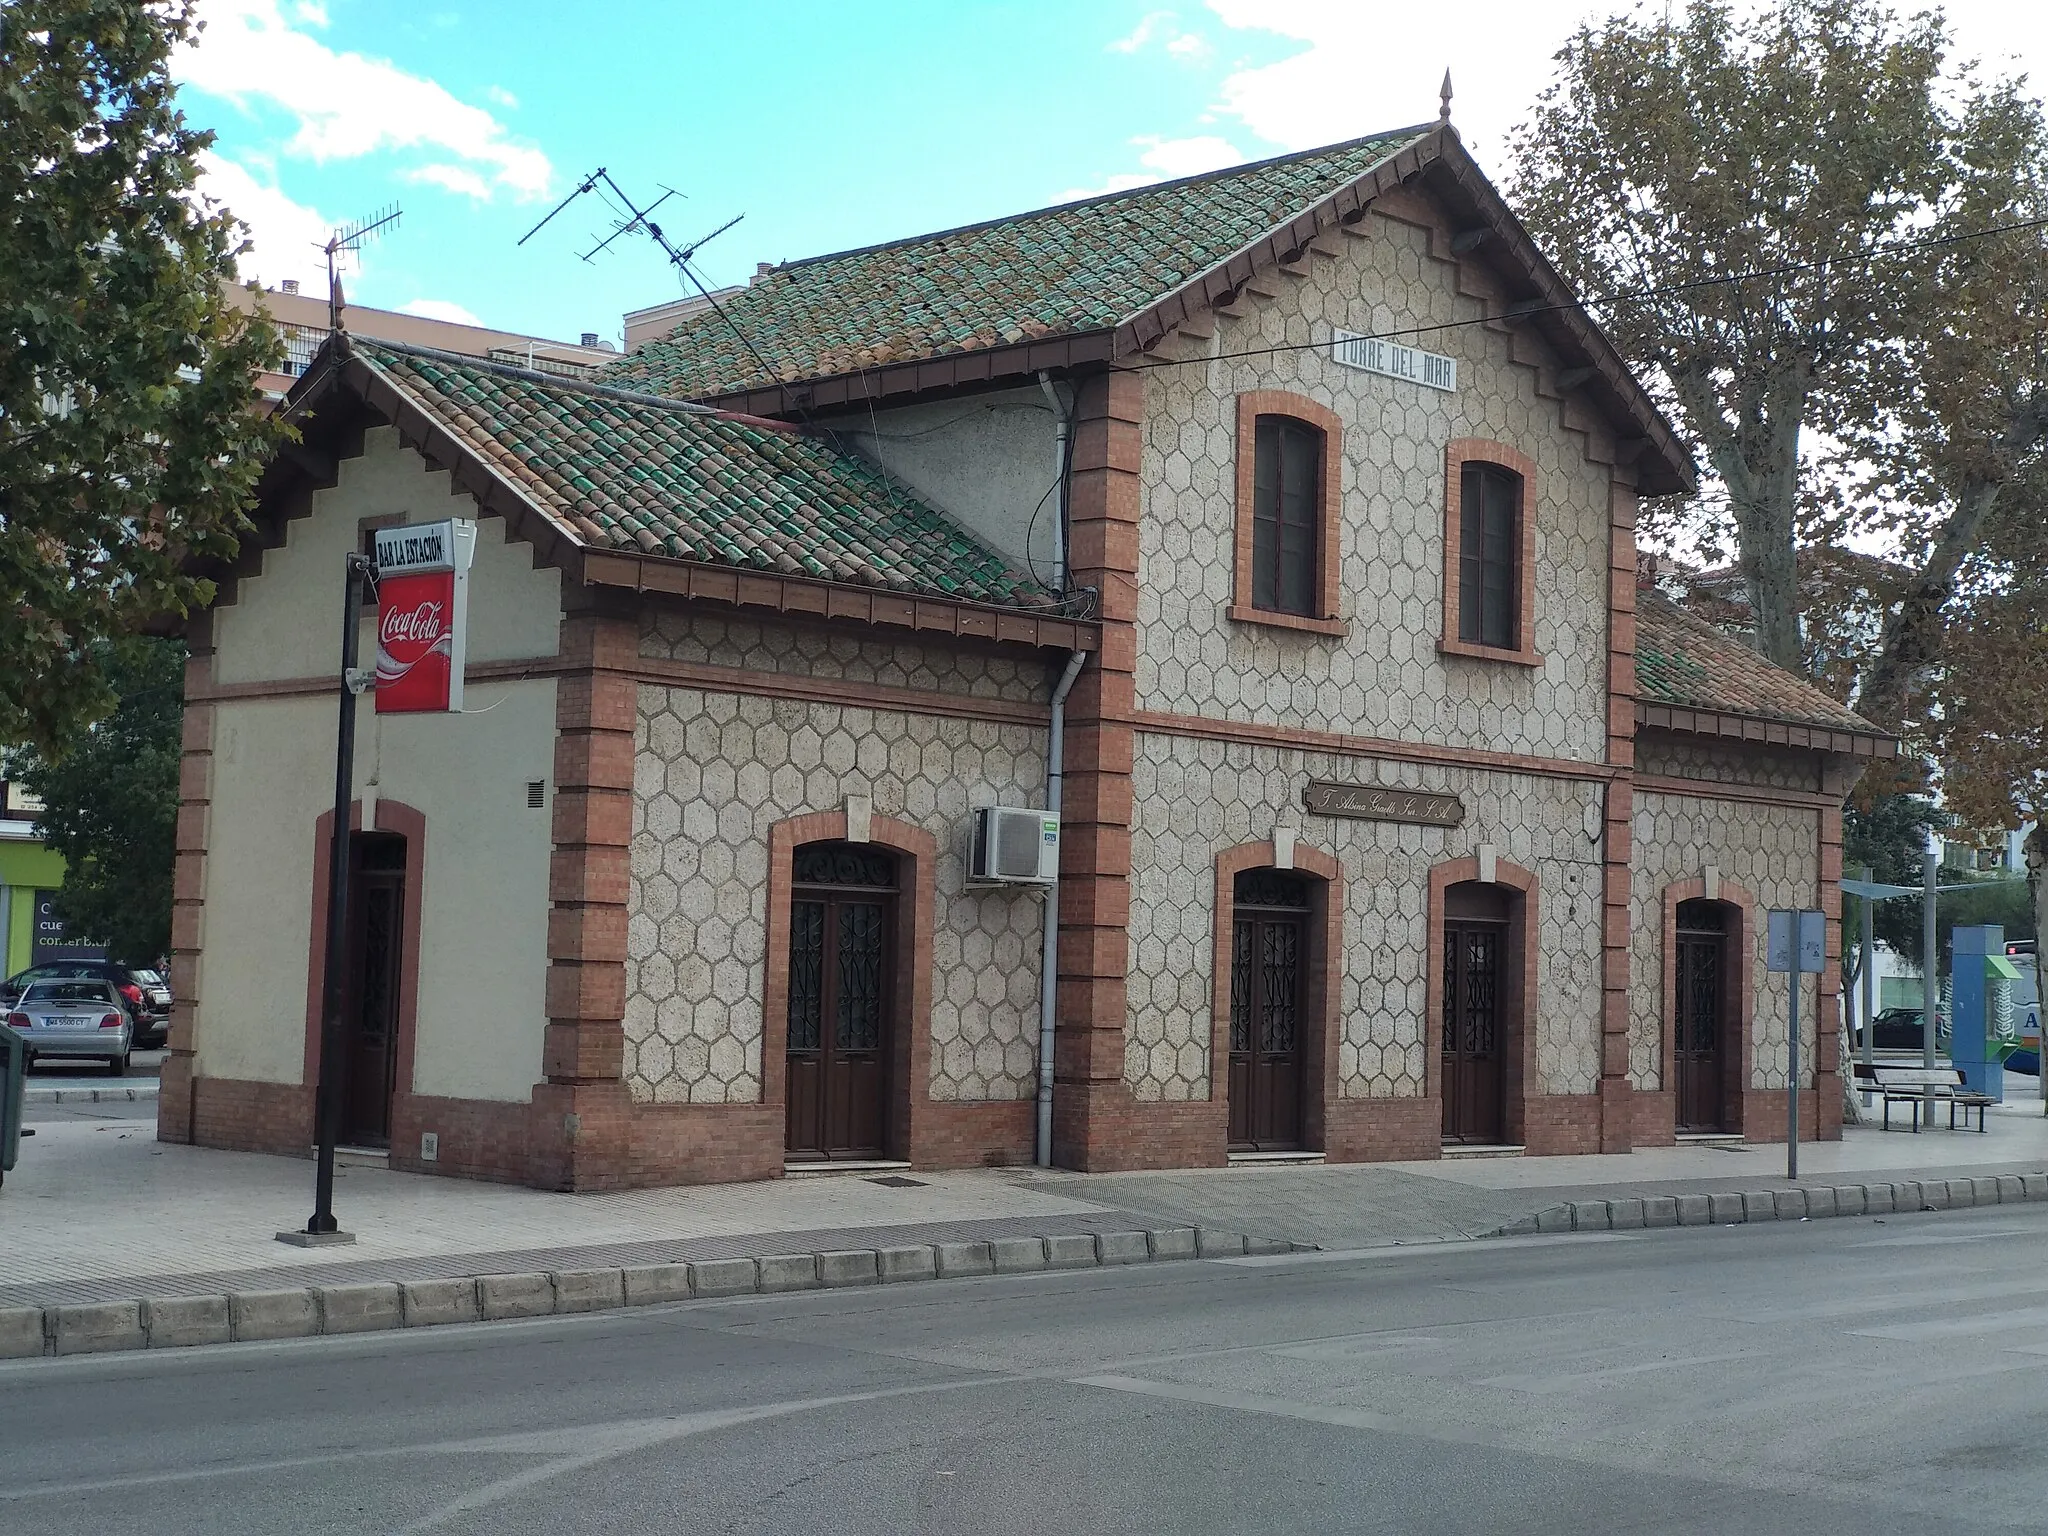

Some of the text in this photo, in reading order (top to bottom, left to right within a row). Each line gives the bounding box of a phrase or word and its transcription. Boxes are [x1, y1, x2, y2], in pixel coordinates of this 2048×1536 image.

[1341, 333, 1451, 387] TORRE DEL MAR
[378, 528, 443, 568] BAR LA ESTACIÓN
[1336, 792, 1367, 811] Alsina
[1370, 793, 1396, 814] Graells
